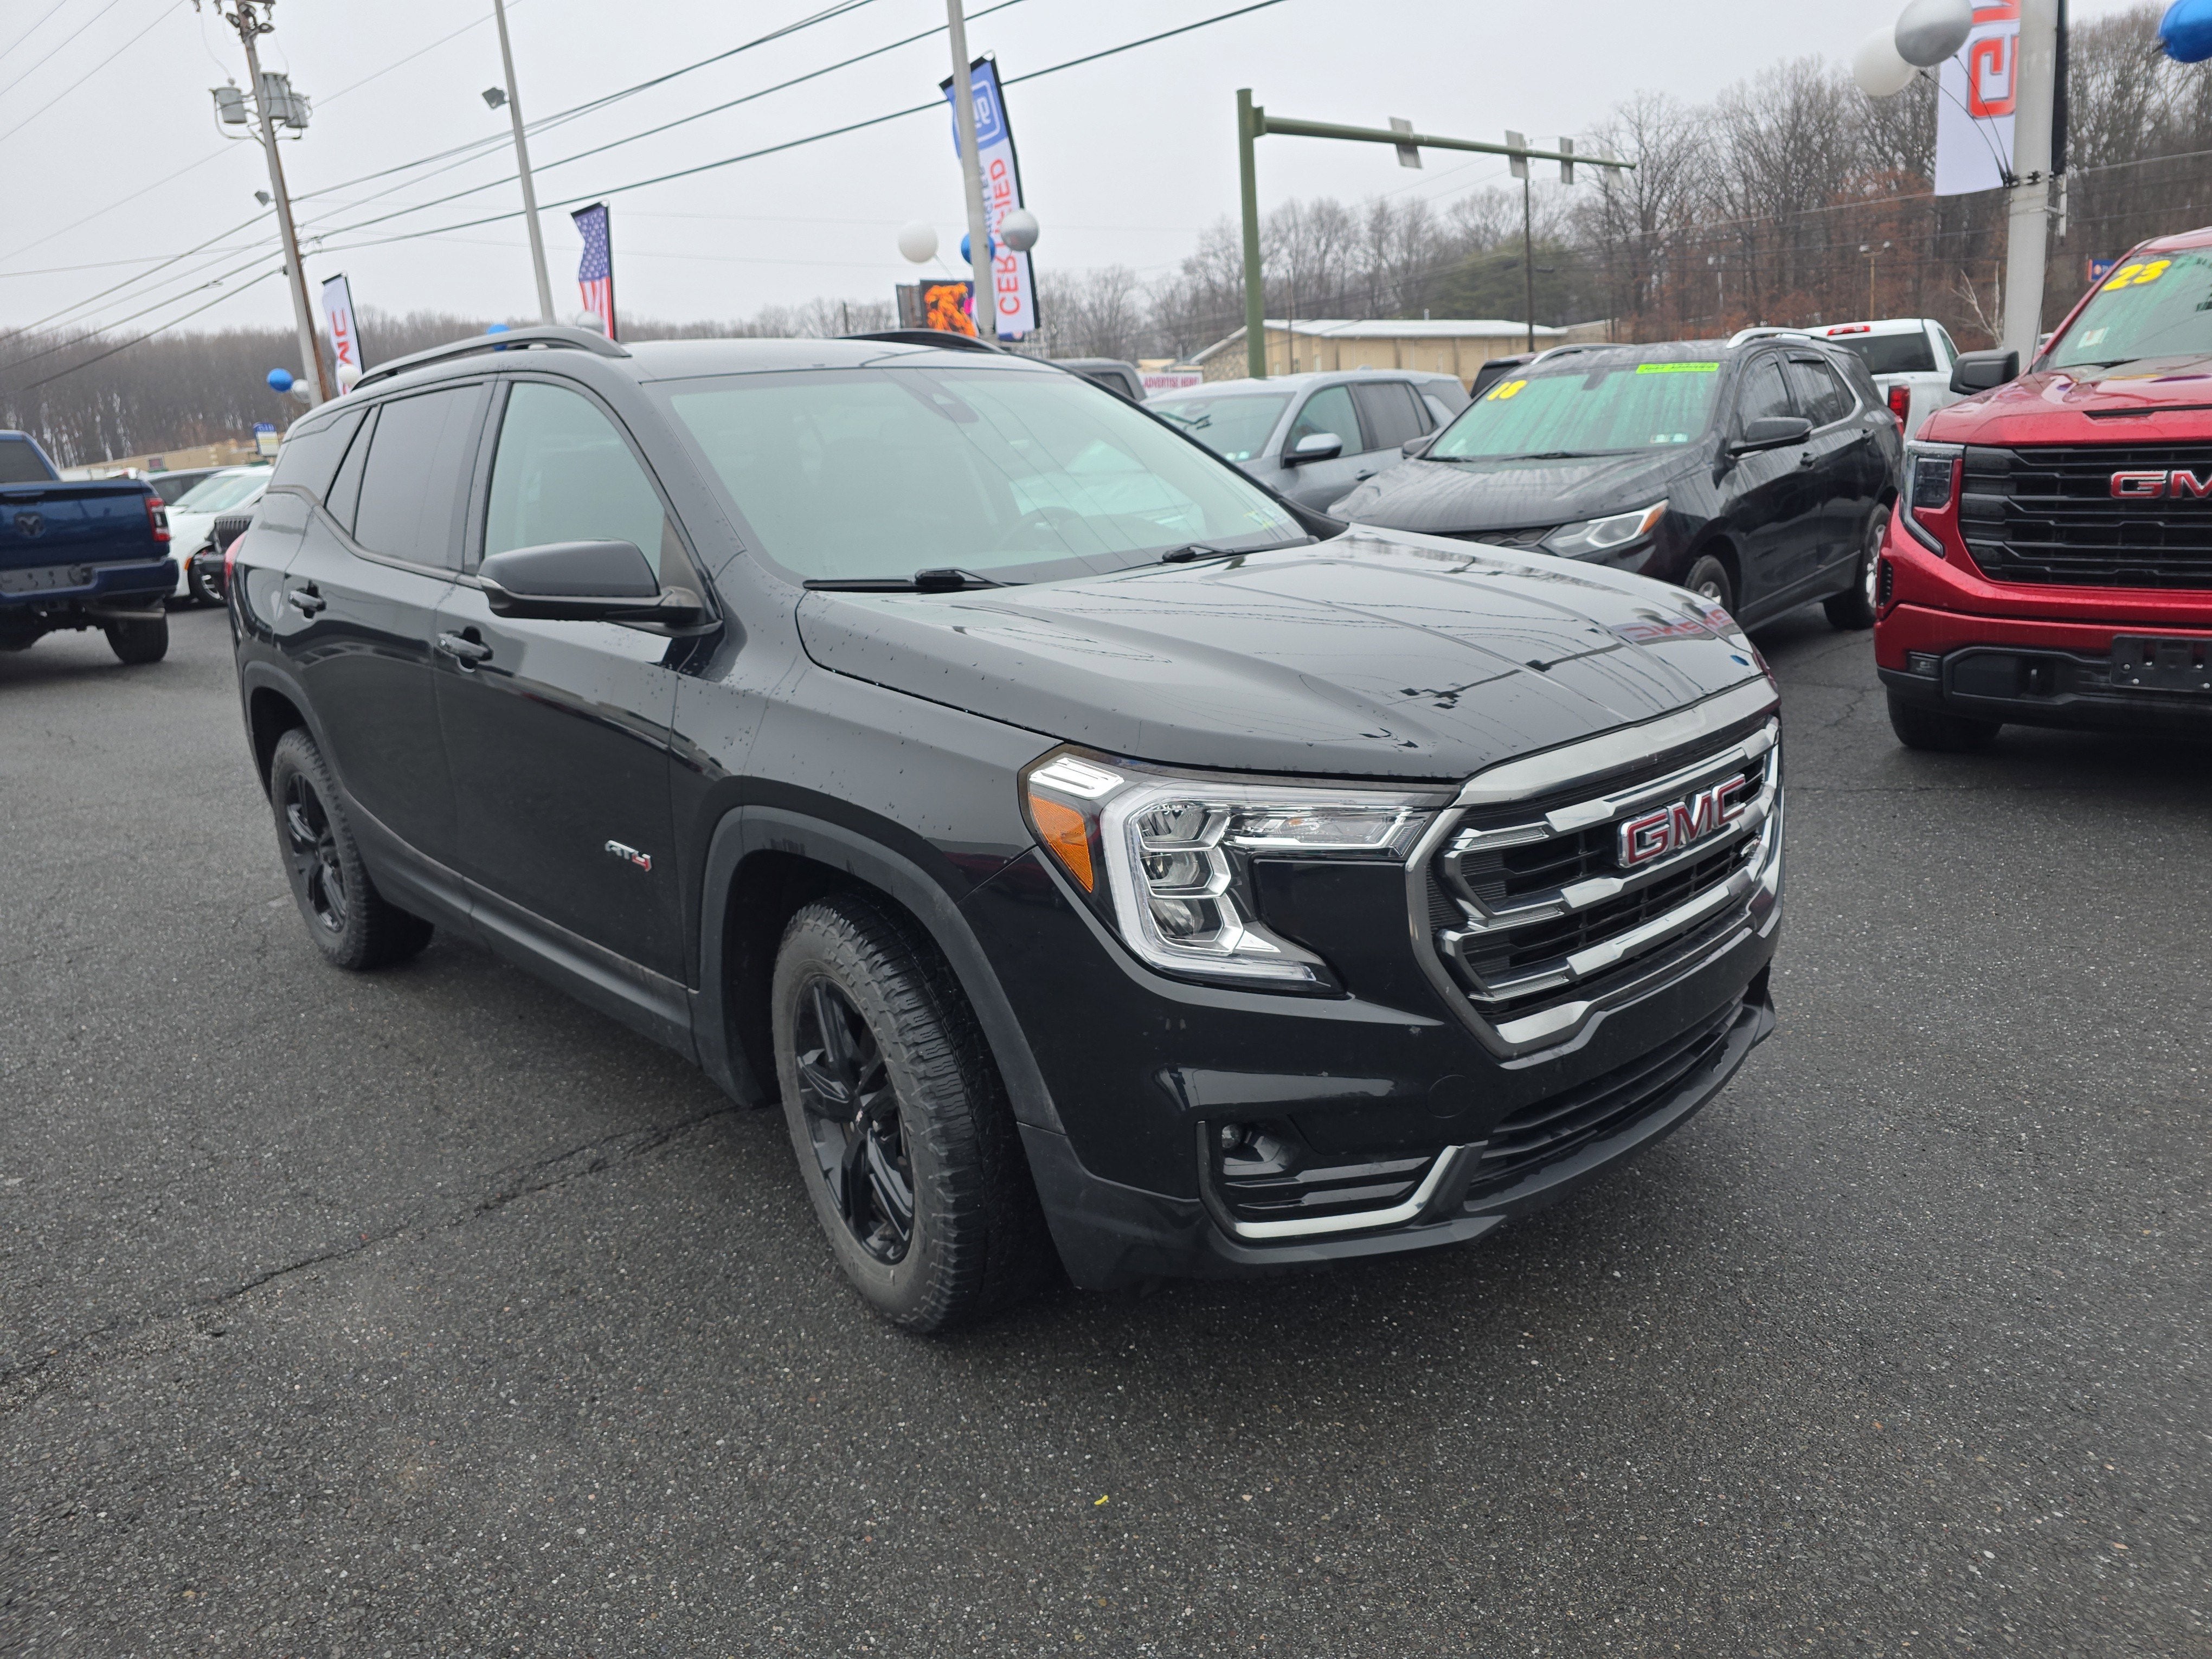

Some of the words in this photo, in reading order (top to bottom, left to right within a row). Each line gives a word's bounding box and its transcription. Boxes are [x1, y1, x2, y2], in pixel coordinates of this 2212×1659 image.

[2102, 260, 2171, 291] 23
[1618, 772, 1747, 869] GMC
[605, 840, 652, 872] AT4
